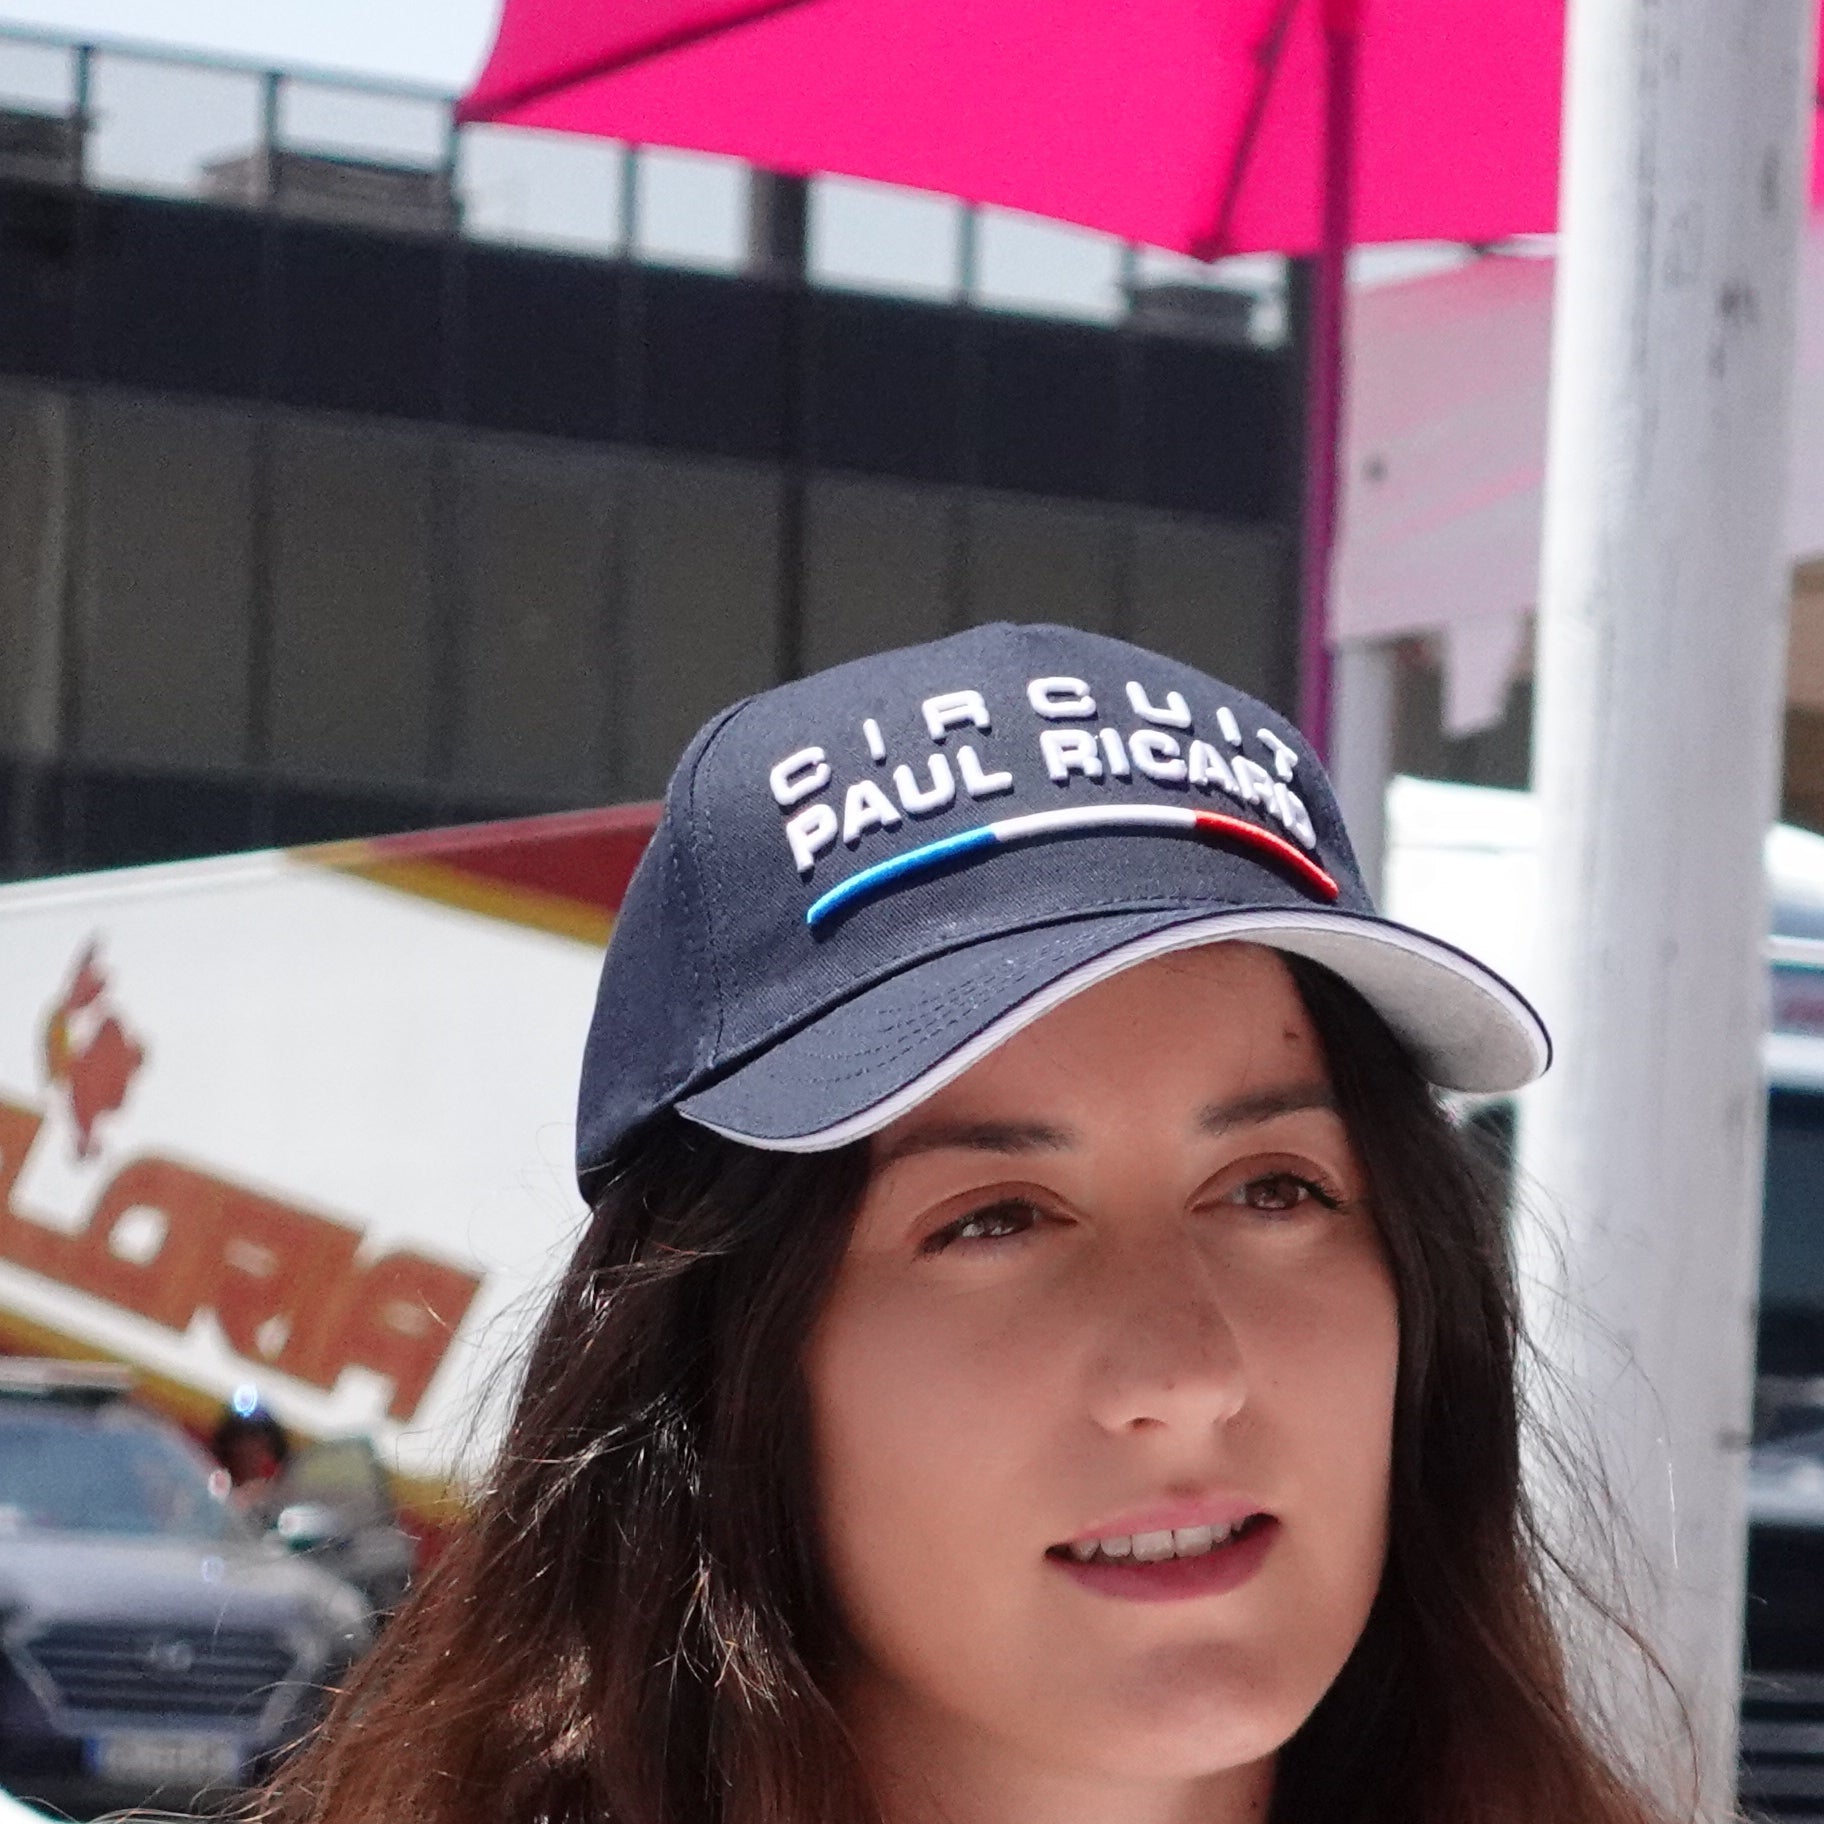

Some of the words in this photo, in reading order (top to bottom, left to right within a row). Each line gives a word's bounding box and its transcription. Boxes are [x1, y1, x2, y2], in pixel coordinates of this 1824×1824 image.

[769, 676, 1299, 805] CIRCUIT
[783, 745, 1013, 873] PAUL
[1039, 726, 1318, 850] RICARD
